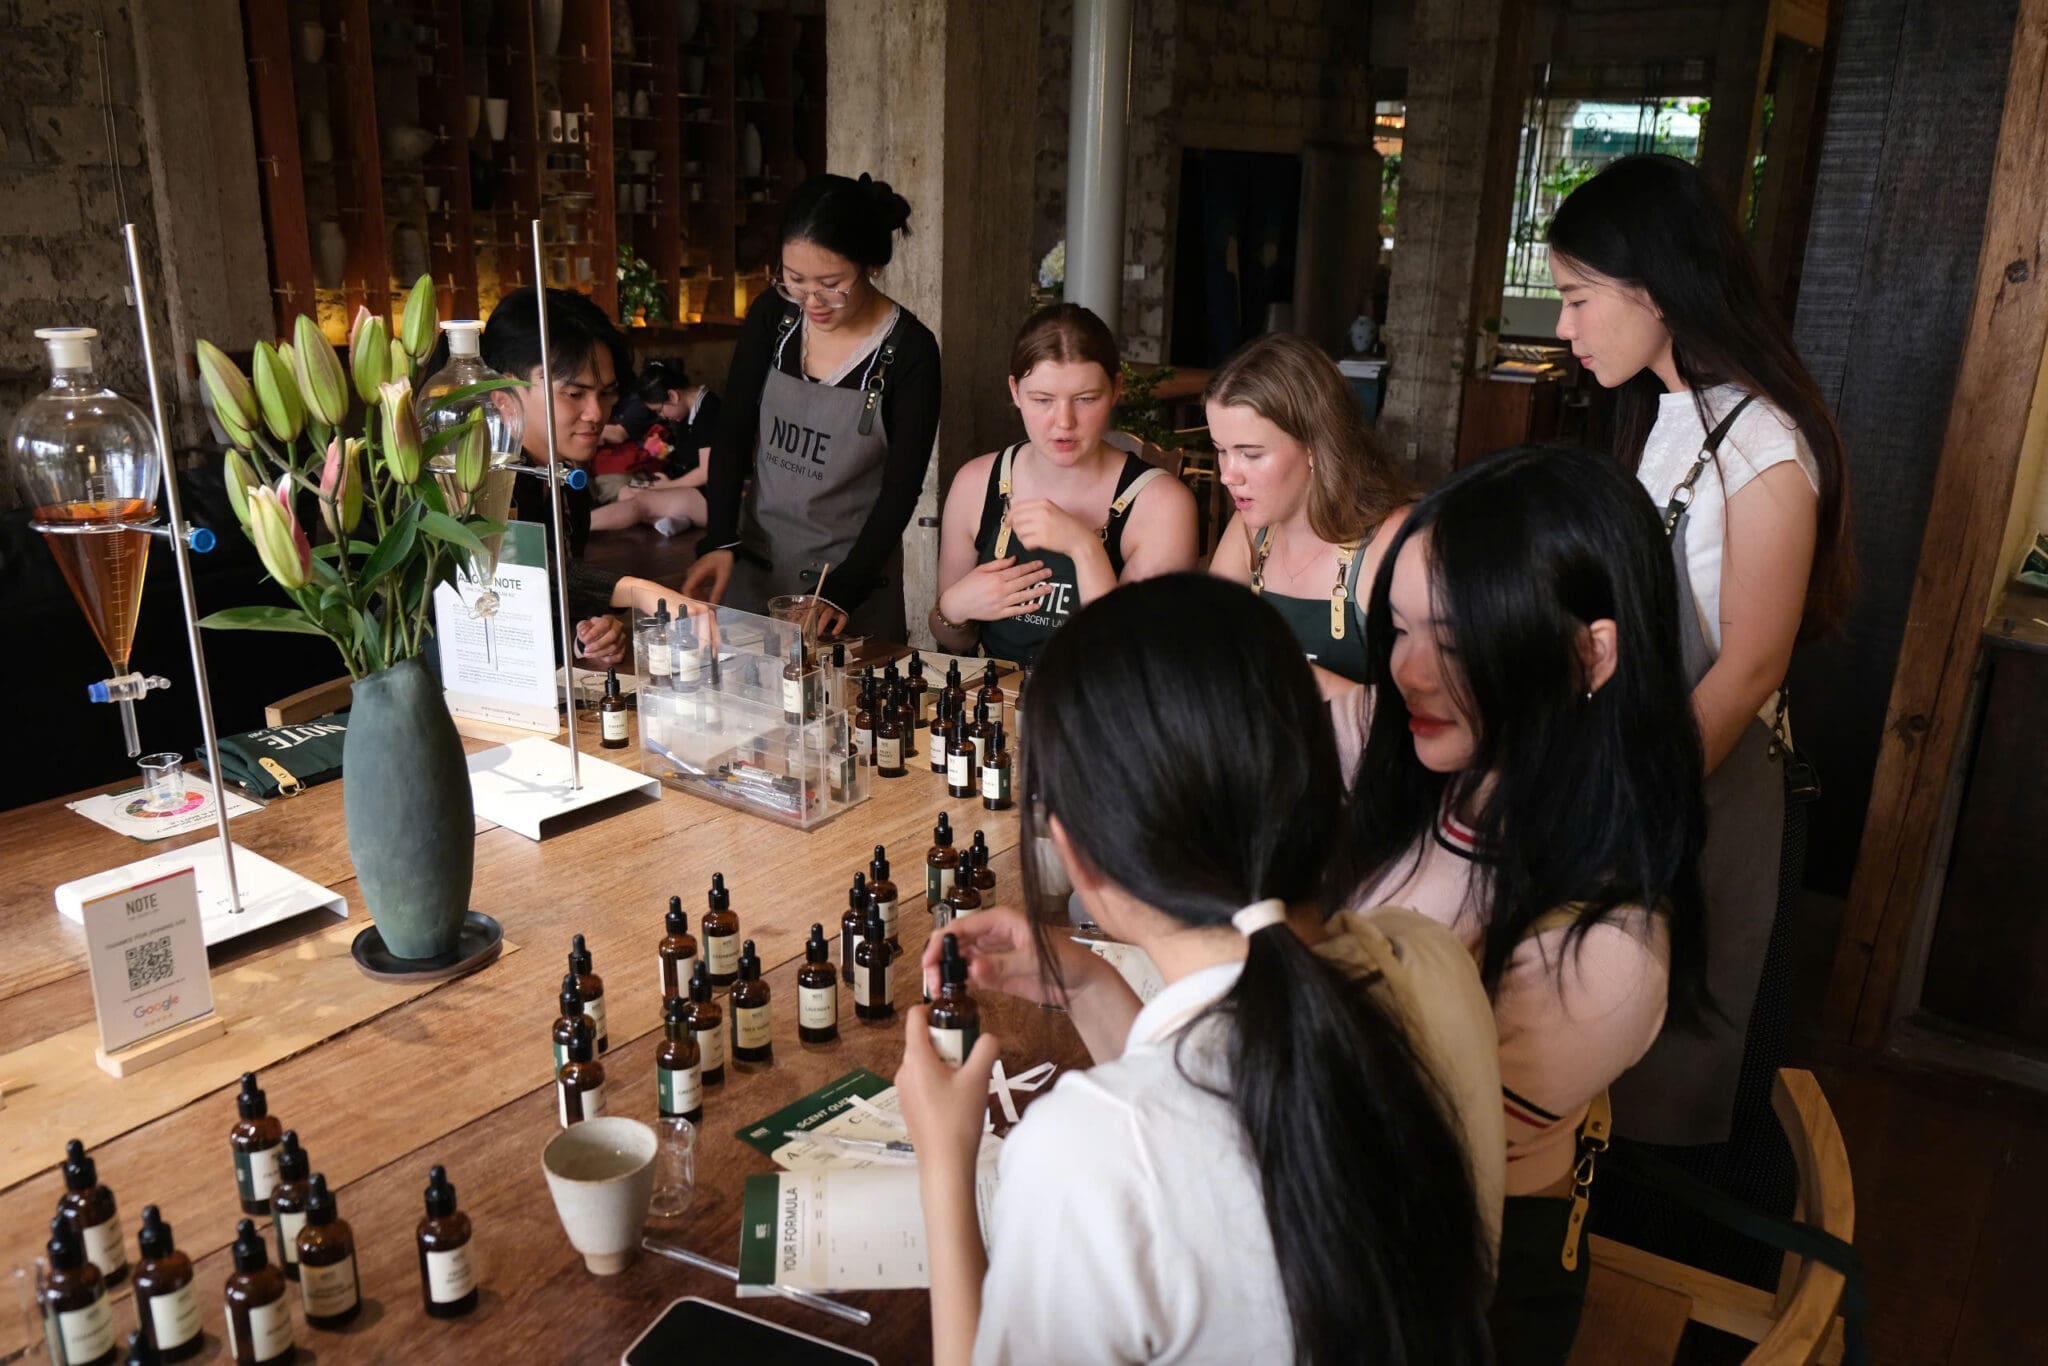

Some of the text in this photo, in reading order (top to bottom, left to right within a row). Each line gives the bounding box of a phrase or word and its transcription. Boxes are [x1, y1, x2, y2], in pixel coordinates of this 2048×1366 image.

[769, 416, 831, 465] NOTE
[766, 453, 823, 480] THE SCENT LAB
[494, 577, 521, 591] NOTE
[1024, 613, 1050, 627] SCENT
[258, 724, 347, 750] NOTE
[126, 893, 158, 915] NOTE
[134, 995, 179, 1019] Google
[796, 1109, 828, 1129] SCENT
[783, 1187, 798, 1273] YOUR FORMULA
